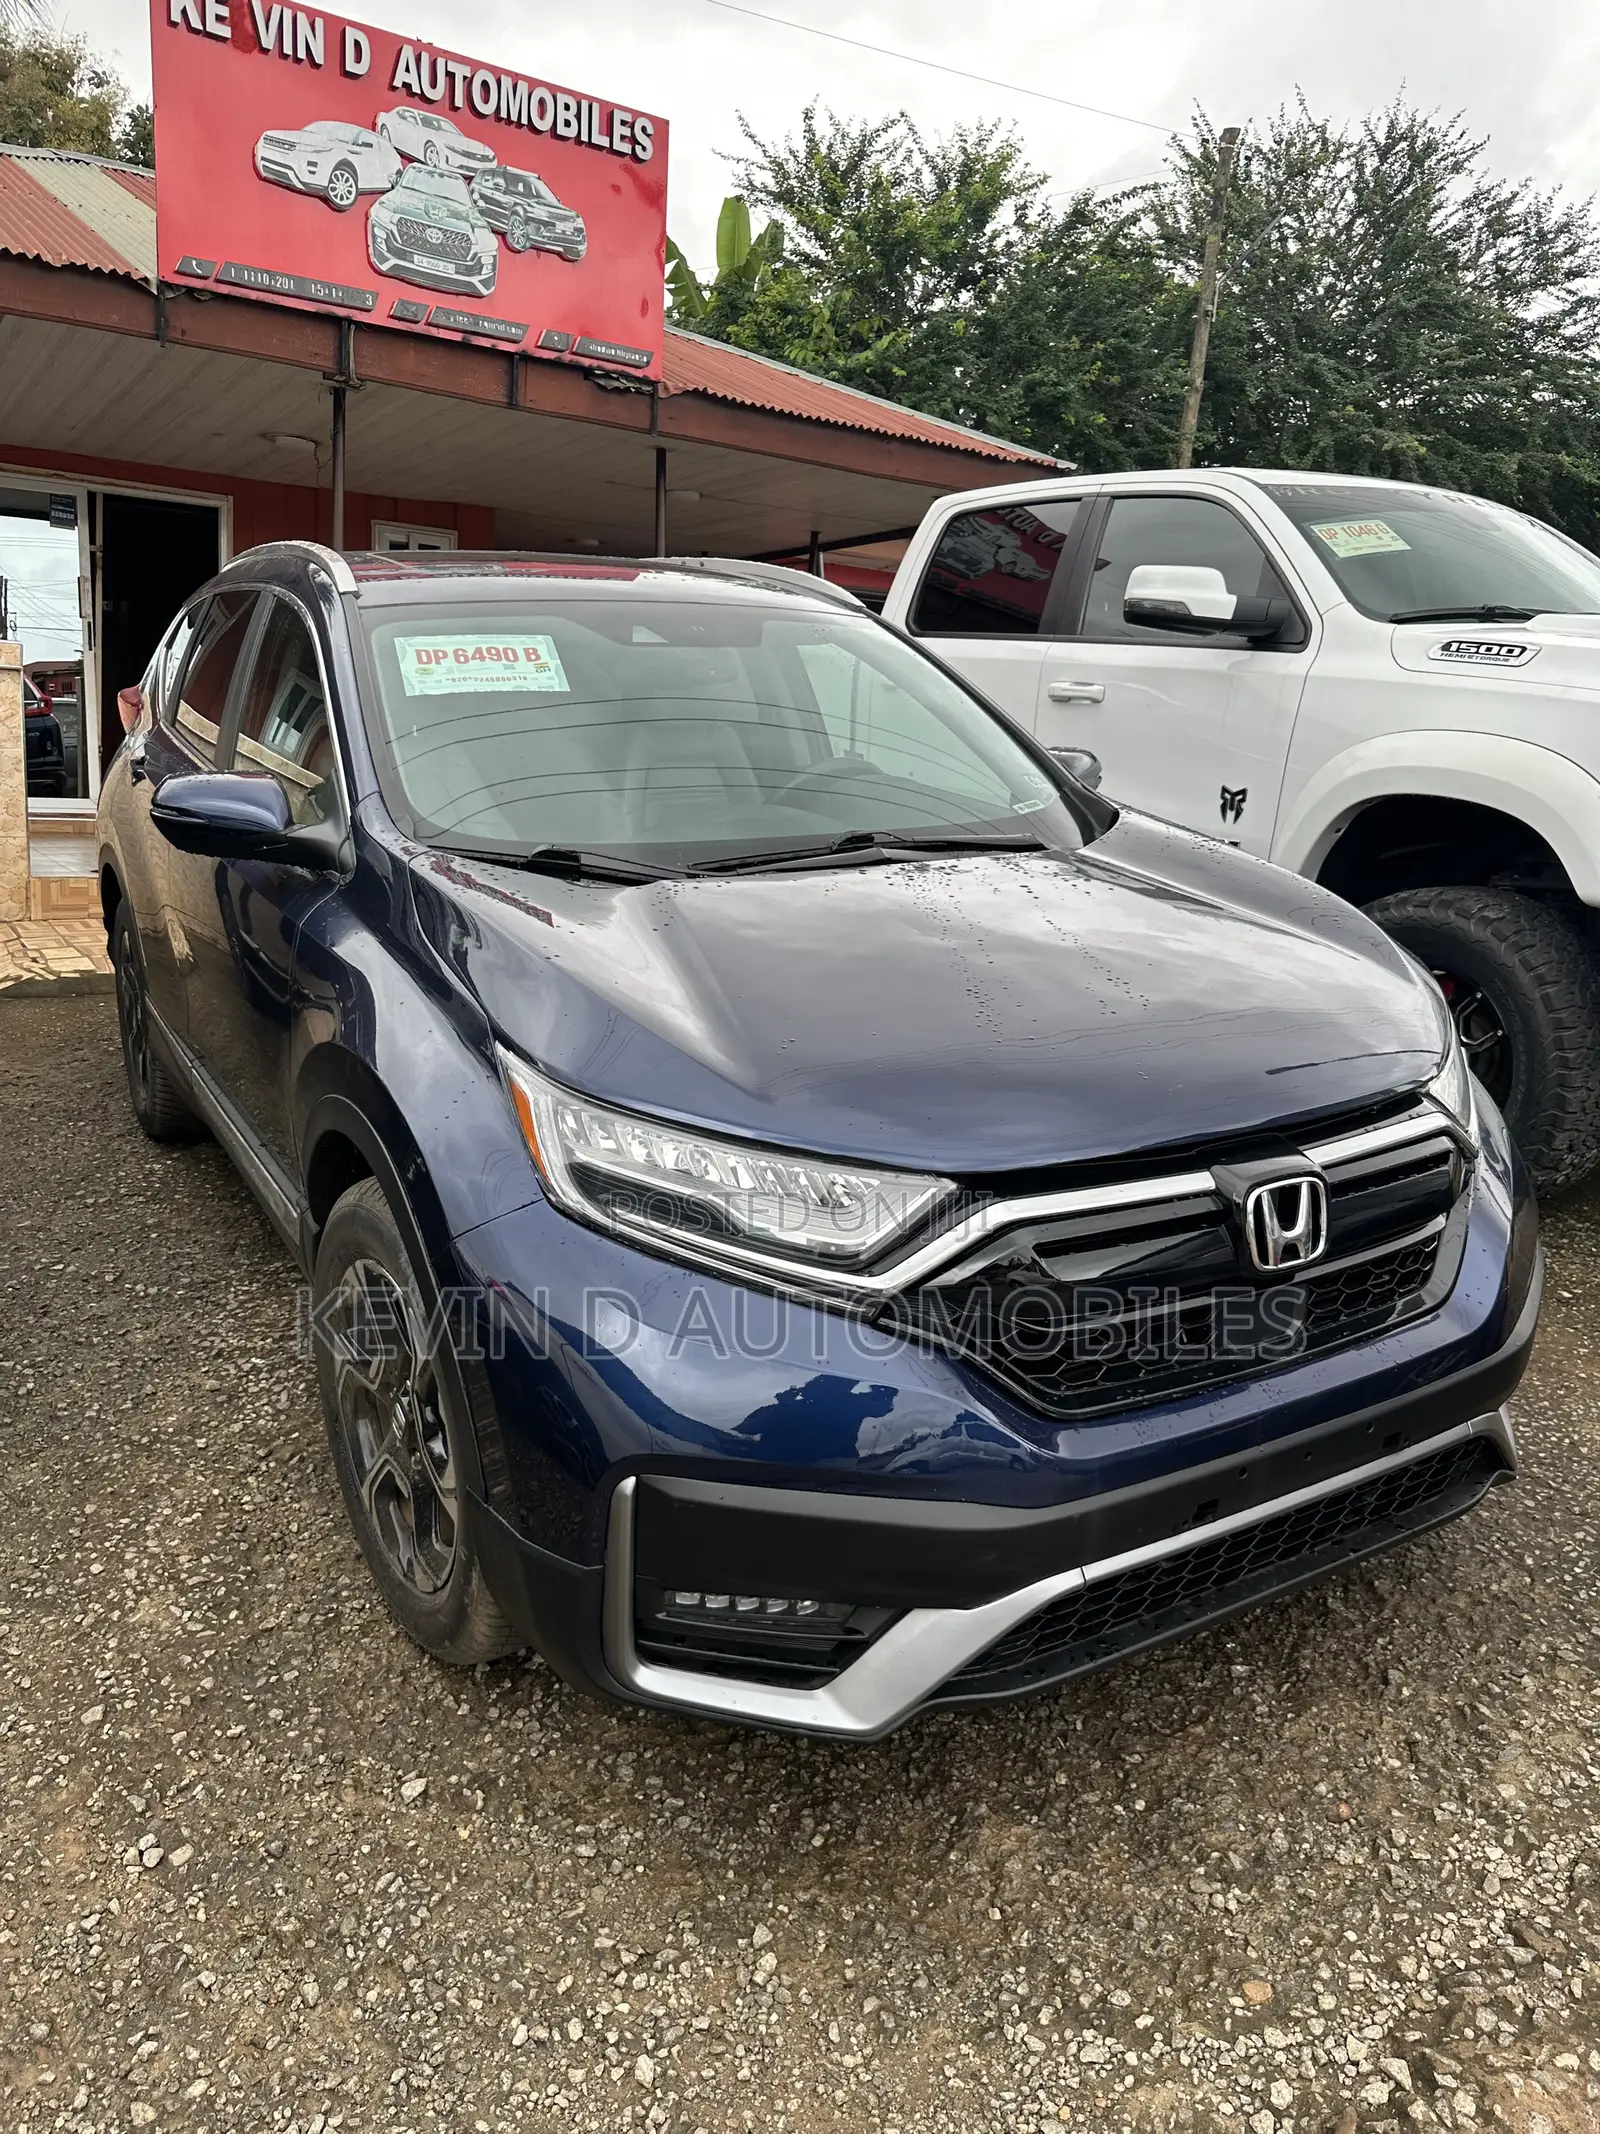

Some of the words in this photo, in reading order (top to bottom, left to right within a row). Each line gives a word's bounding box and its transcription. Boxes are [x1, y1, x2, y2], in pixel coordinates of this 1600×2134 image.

[343, 25, 371, 76] D
[391, 44, 655, 162] AUTOMOBILES
[1340, 524, 1378, 538] 1046
[415, 648, 449, 665] DP
[452, 646, 519, 664] 6490
[522, 647, 542, 663] B
[1440, 652, 1466, 660] HEMI
[1449, 642, 1522, 656] 1500
